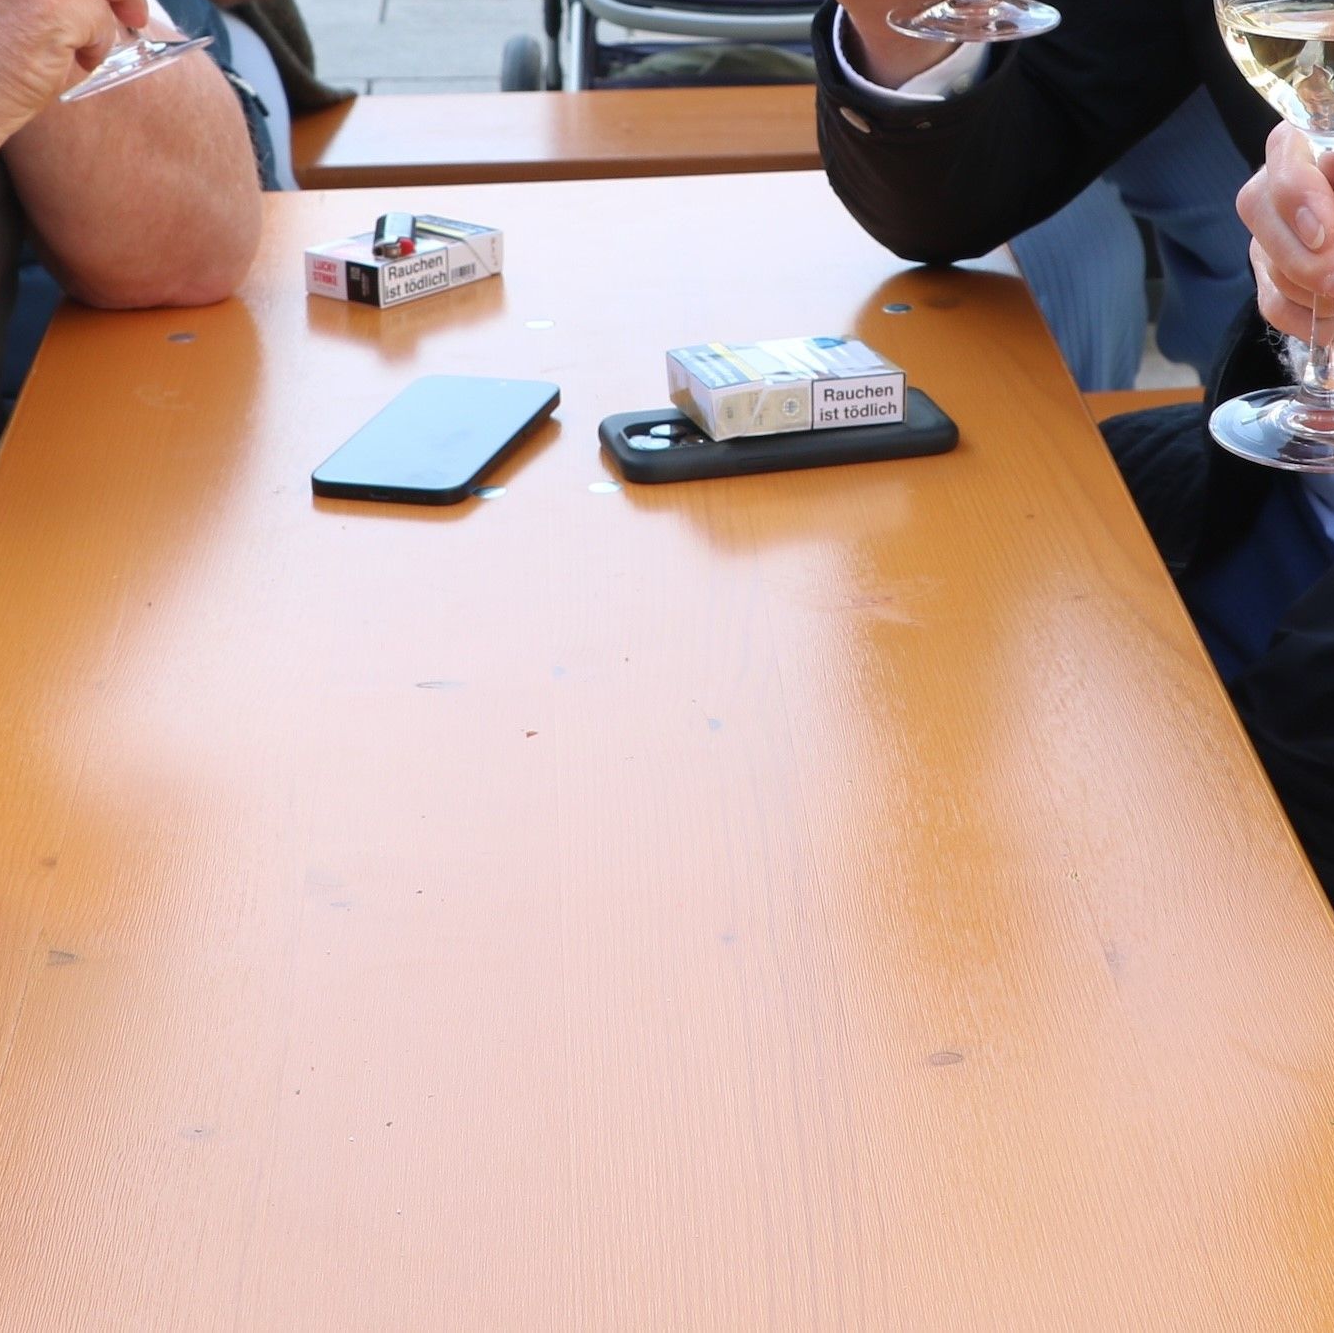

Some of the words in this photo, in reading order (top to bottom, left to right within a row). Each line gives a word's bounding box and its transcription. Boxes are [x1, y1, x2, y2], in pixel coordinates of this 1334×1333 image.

[389, 254, 443, 281] Rauchen
[386, 286, 401, 298] ist
[404, 270, 446, 293] tödlich
[824, 384, 894, 402] Rauchen
[820, 407, 839, 422] ist
[844, 402, 897, 420] tödlich
